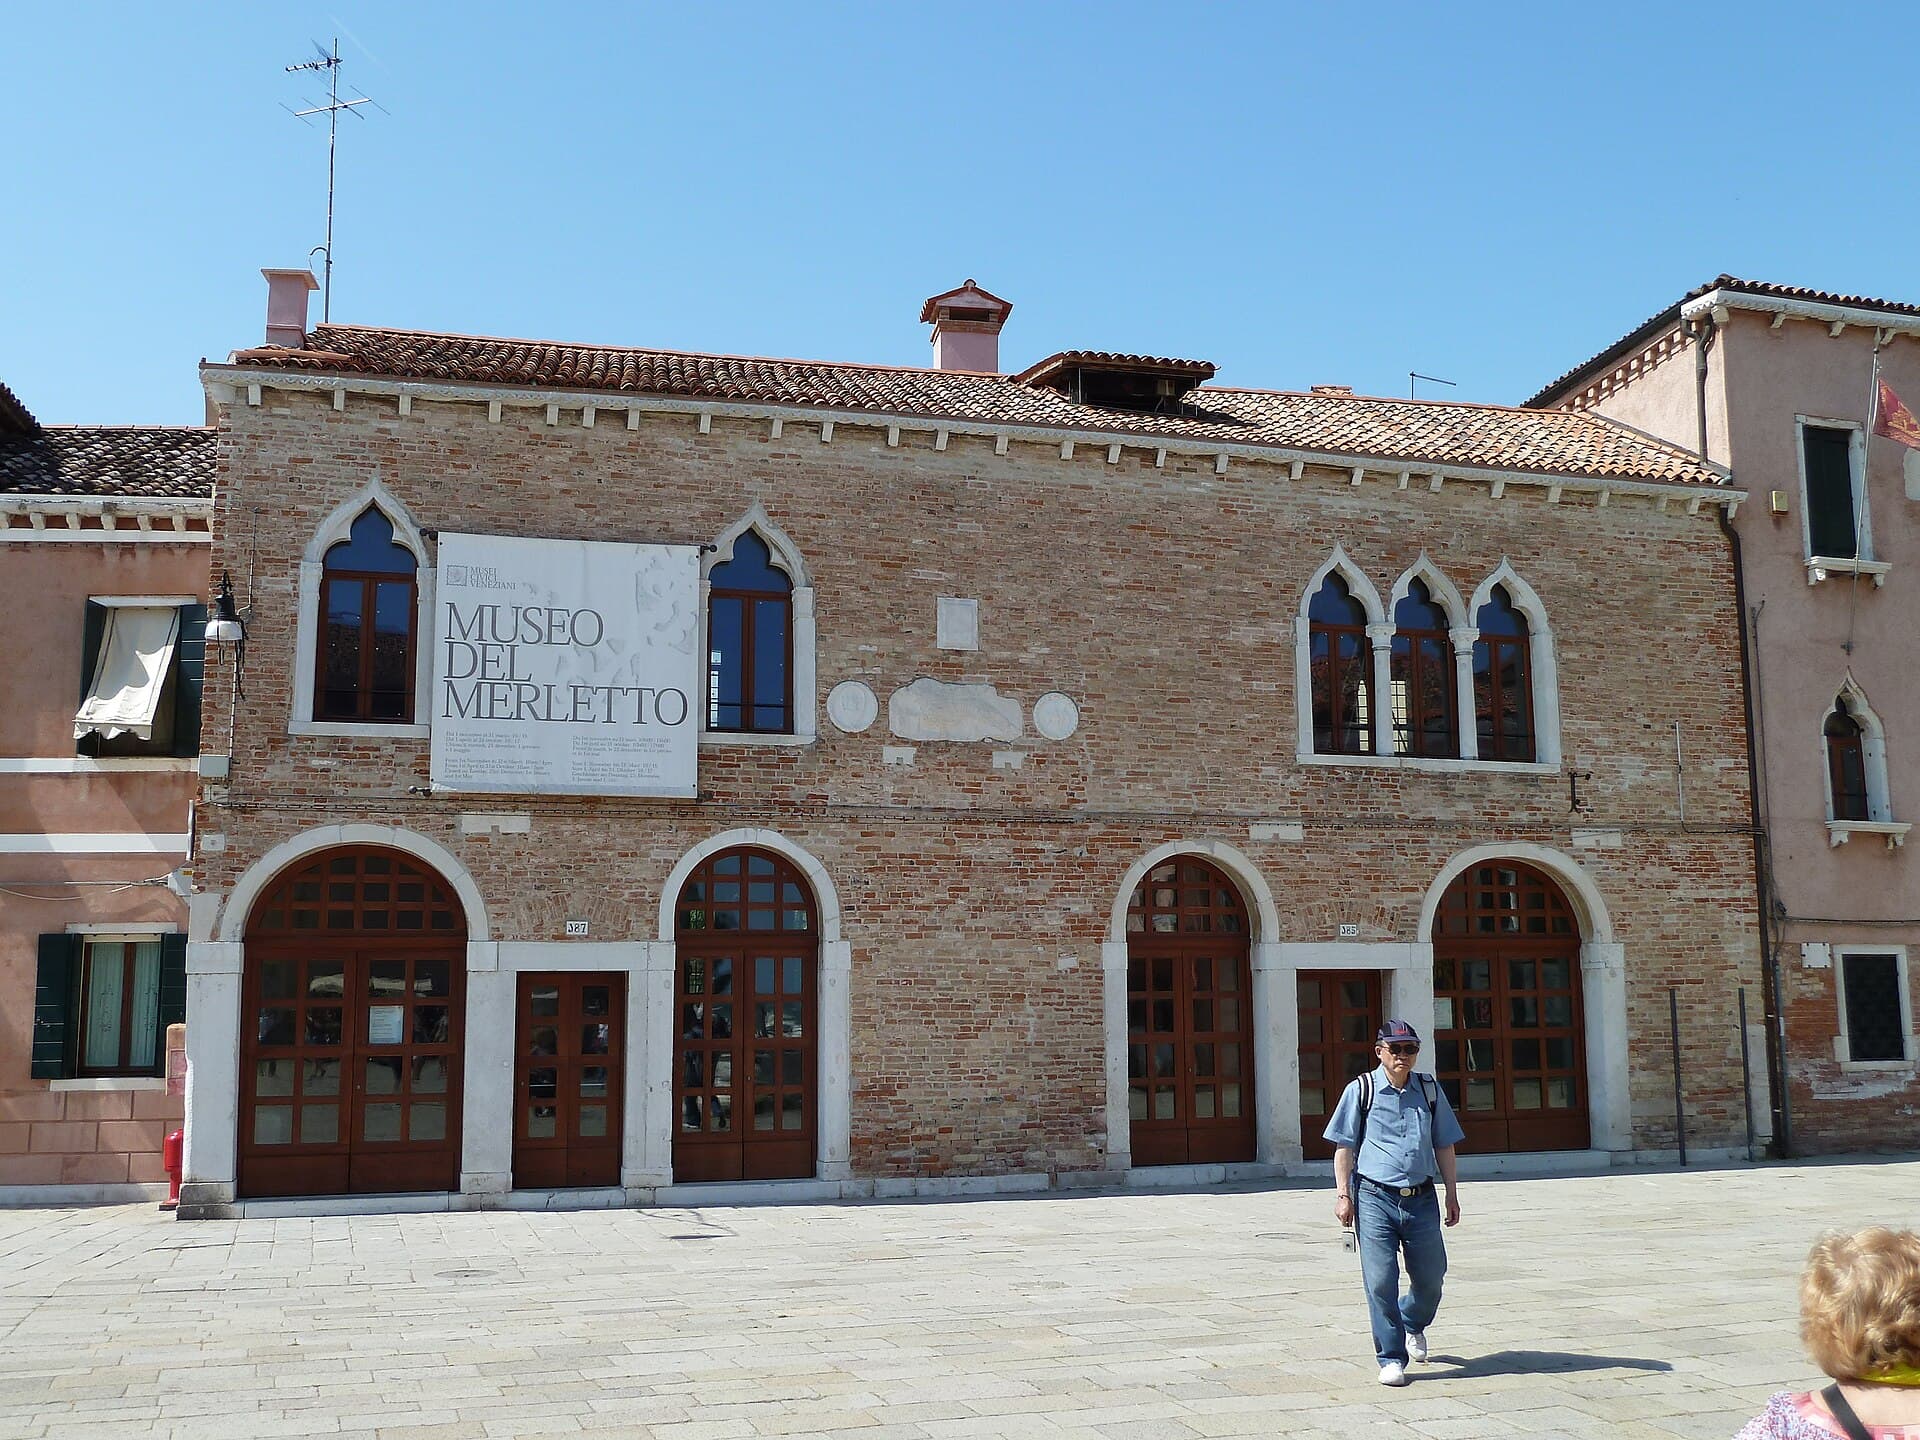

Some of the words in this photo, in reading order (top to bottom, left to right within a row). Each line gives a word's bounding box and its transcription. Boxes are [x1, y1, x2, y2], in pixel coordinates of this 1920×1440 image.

[471, 566, 497, 575] MUSEI
[471, 574, 497, 582] CIVICI
[470, 580, 516, 590] VENEZIANI
[444, 602, 604, 647] MUSEO
[443, 641, 532, 682] DEL
[441, 680, 688, 726] MERLETTO
[568, 923, 587, 933] 387
